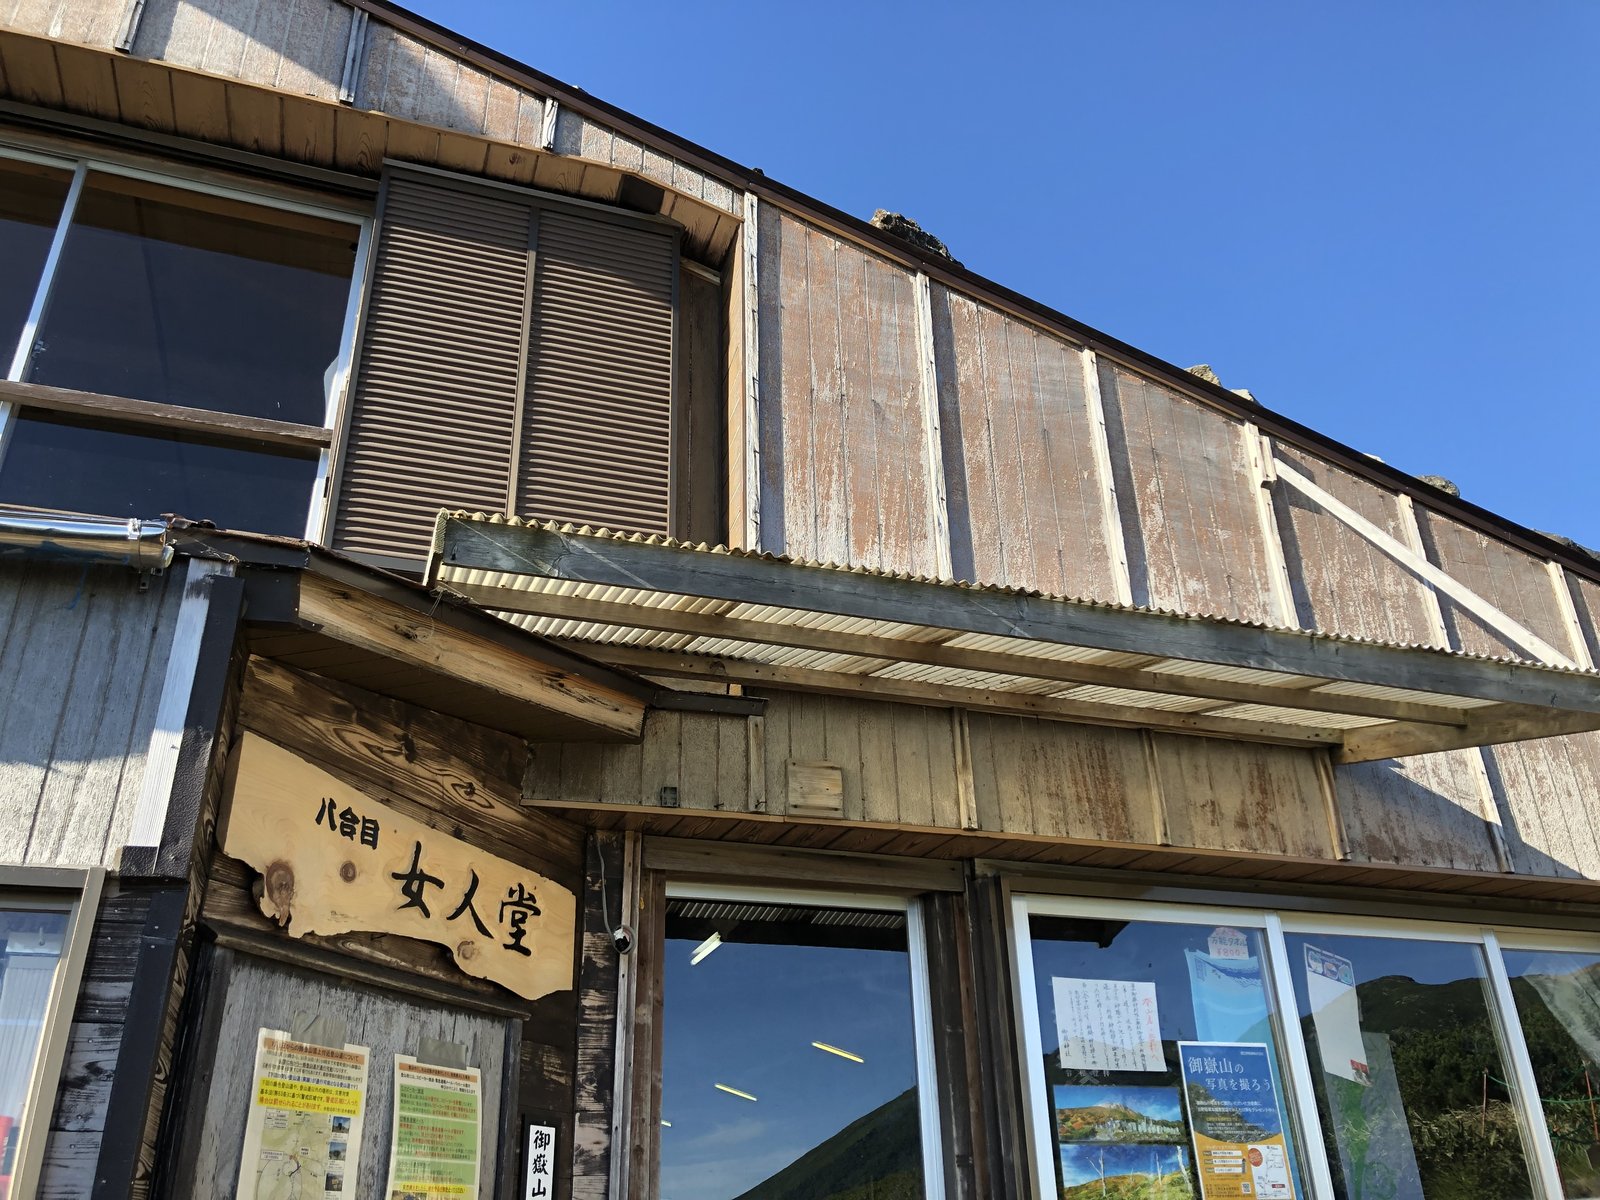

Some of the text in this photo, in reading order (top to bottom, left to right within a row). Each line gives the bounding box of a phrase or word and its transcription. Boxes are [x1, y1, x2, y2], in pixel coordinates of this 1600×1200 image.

[315, 797, 380, 850] 八合目
[391, 840, 541, 956] 女人堂
[1188, 1057, 1244, 1074] 御嶽山の
[1205, 1078, 1271, 1091] 写真を撮ろう
[532, 1130, 550, 1197] 御嶽山
